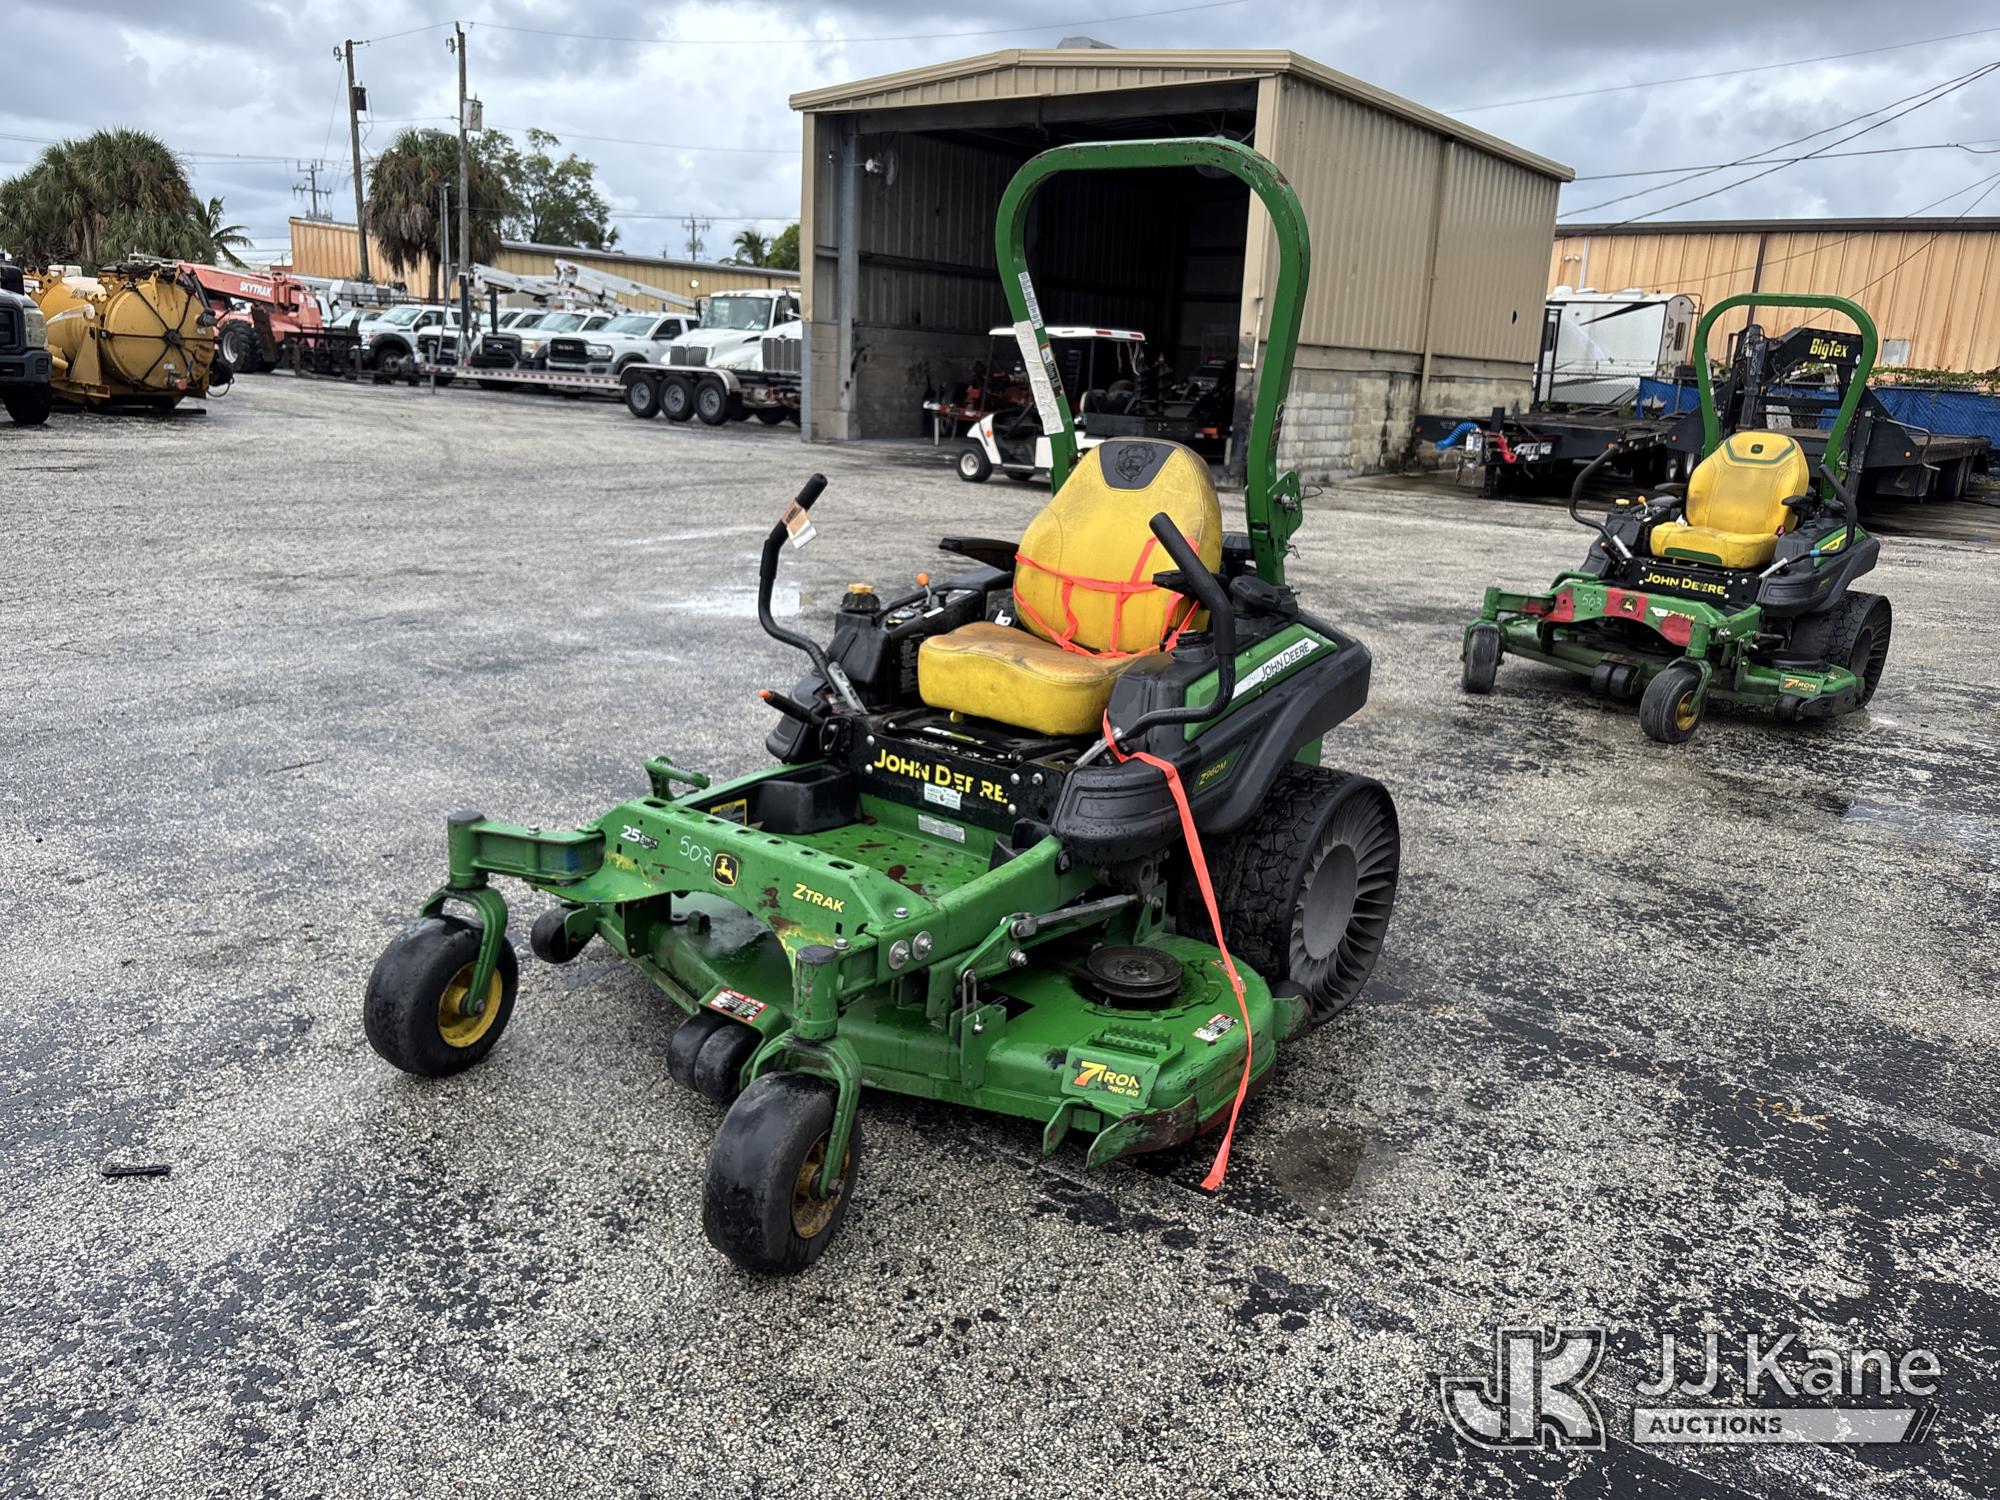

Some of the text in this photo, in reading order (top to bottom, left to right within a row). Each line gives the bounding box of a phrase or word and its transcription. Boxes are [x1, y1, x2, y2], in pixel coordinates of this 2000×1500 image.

[240, 281, 272, 297] SKYTRAK
[1809, 338, 1849, 360] BigTex
[1645, 572, 1726, 595] JOHN DEERE
[1582, 593, 1603, 609] 503
[1262, 641, 1310, 680] JOHN DEERE
[873, 749, 930, 781] JOHN
[792, 883, 845, 912] ZTRAK
